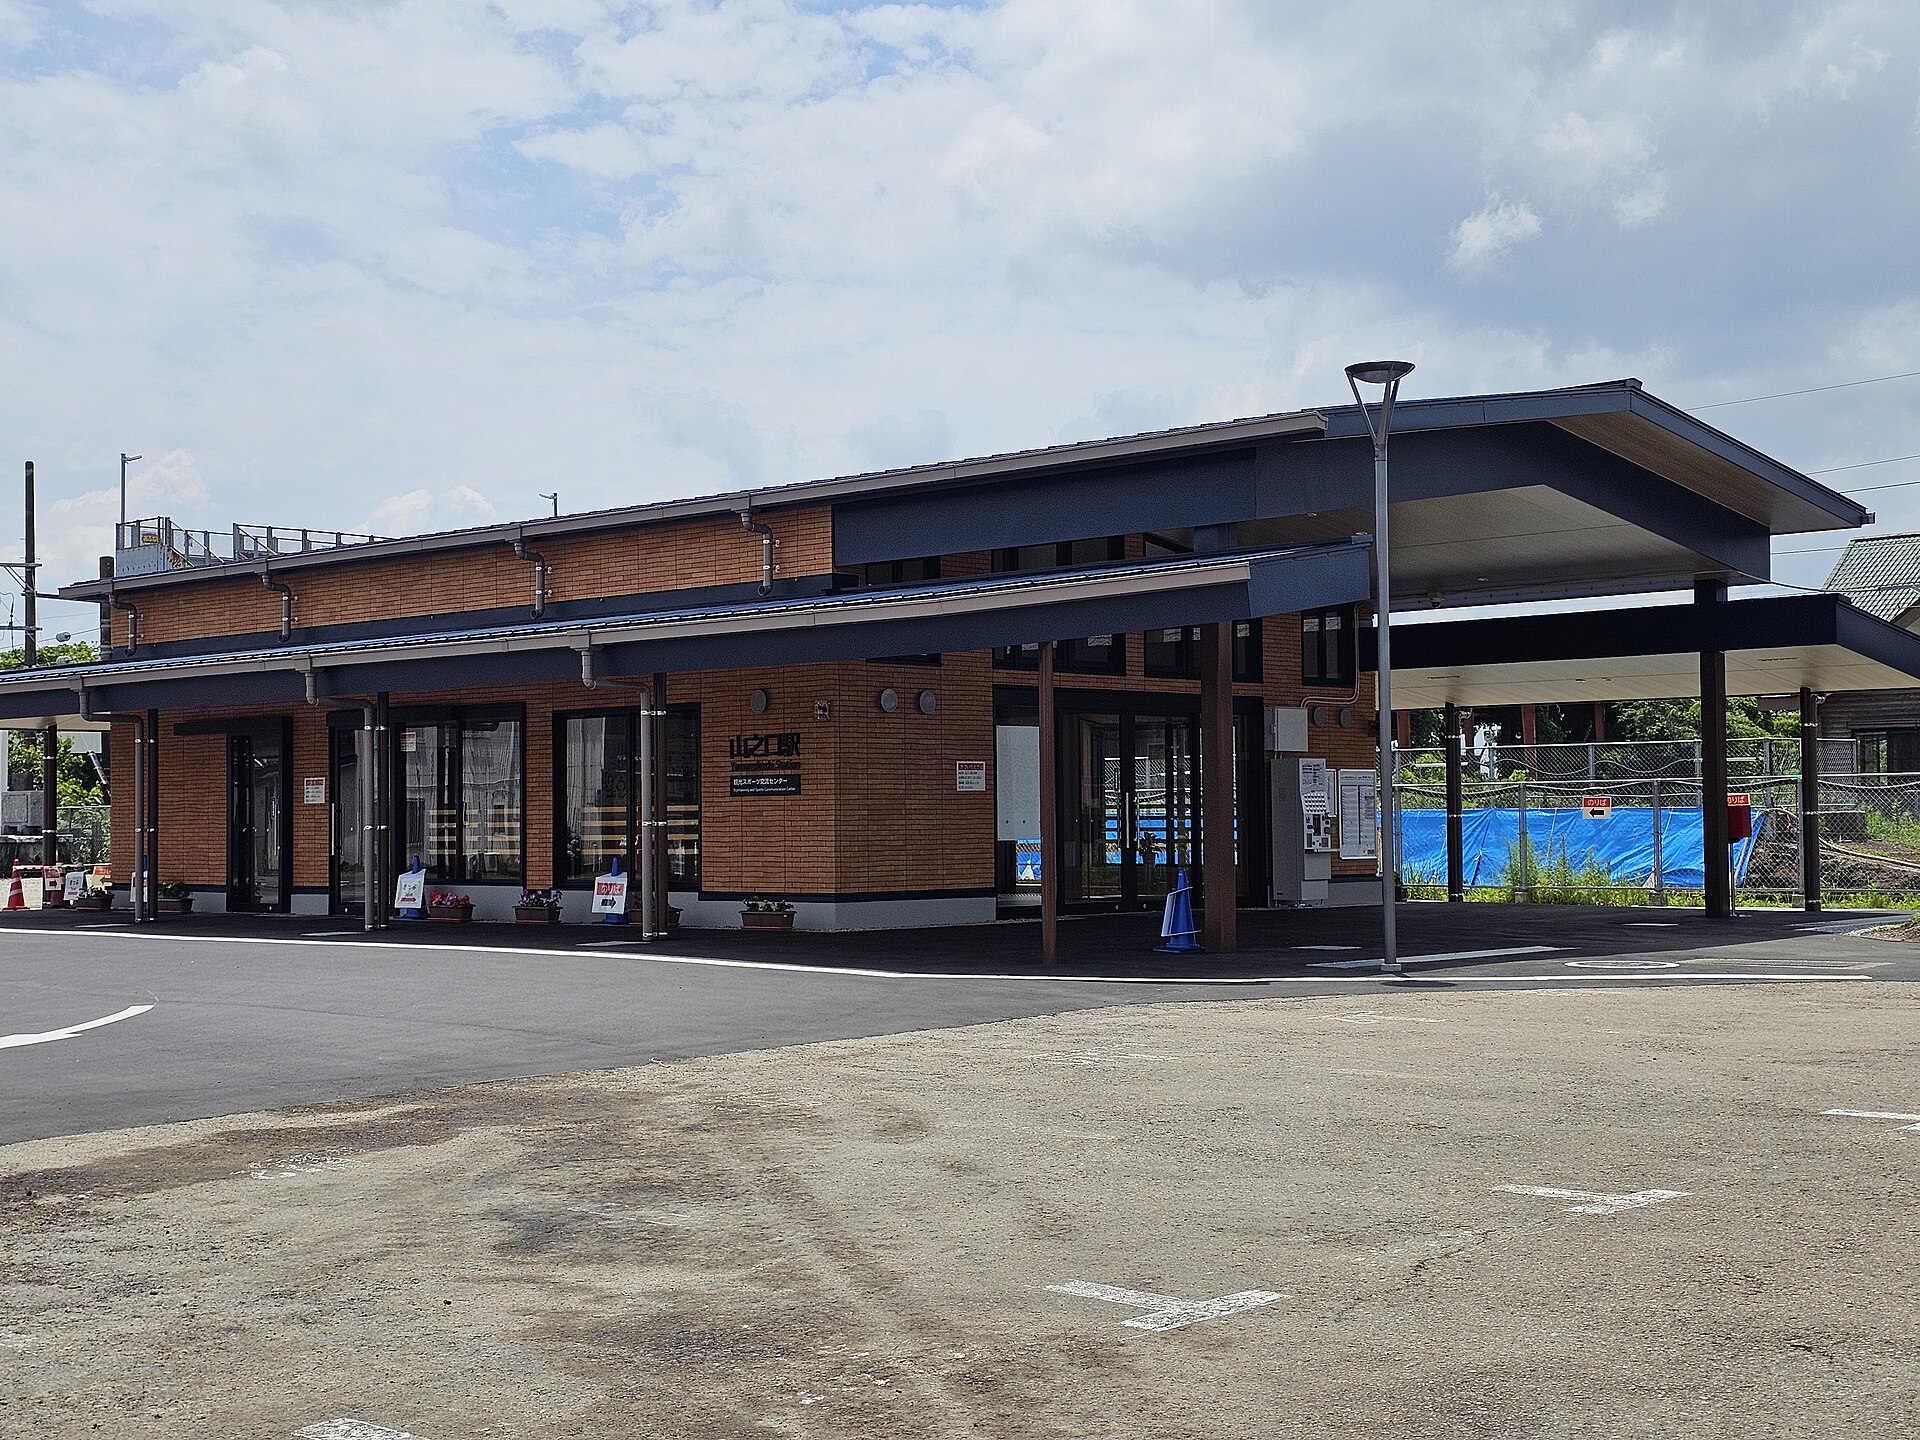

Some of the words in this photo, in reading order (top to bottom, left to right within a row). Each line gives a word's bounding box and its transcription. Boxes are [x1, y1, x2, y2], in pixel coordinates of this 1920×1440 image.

[729, 733, 801, 759] 山之口駅
[601, 884, 623, 895] のりば
